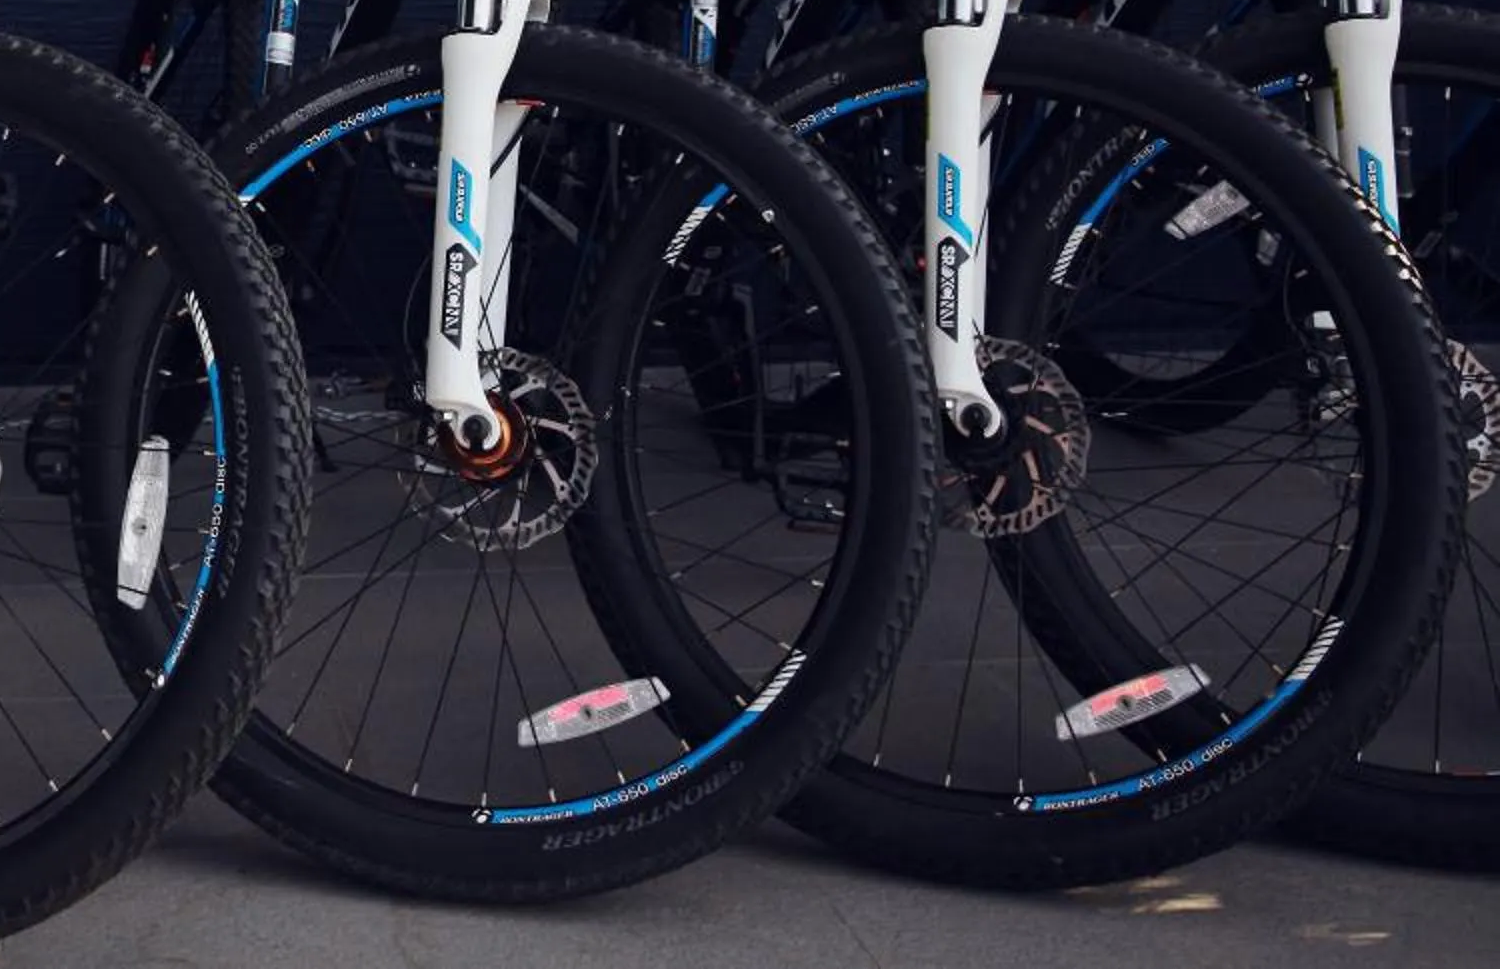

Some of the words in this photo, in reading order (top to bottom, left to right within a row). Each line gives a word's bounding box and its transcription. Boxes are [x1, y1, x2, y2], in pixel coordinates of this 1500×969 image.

[214, 455, 227, 494] disc
[592, 783, 649, 811] AT-650
[655, 764, 688, 787] disc
[1043, 791, 1121, 811] BONTRAGER
[1139, 760, 1195, 790] AT-650
[1201, 738, 1233, 763] disc
[543, 773, 726, 850] BONTRAGER
